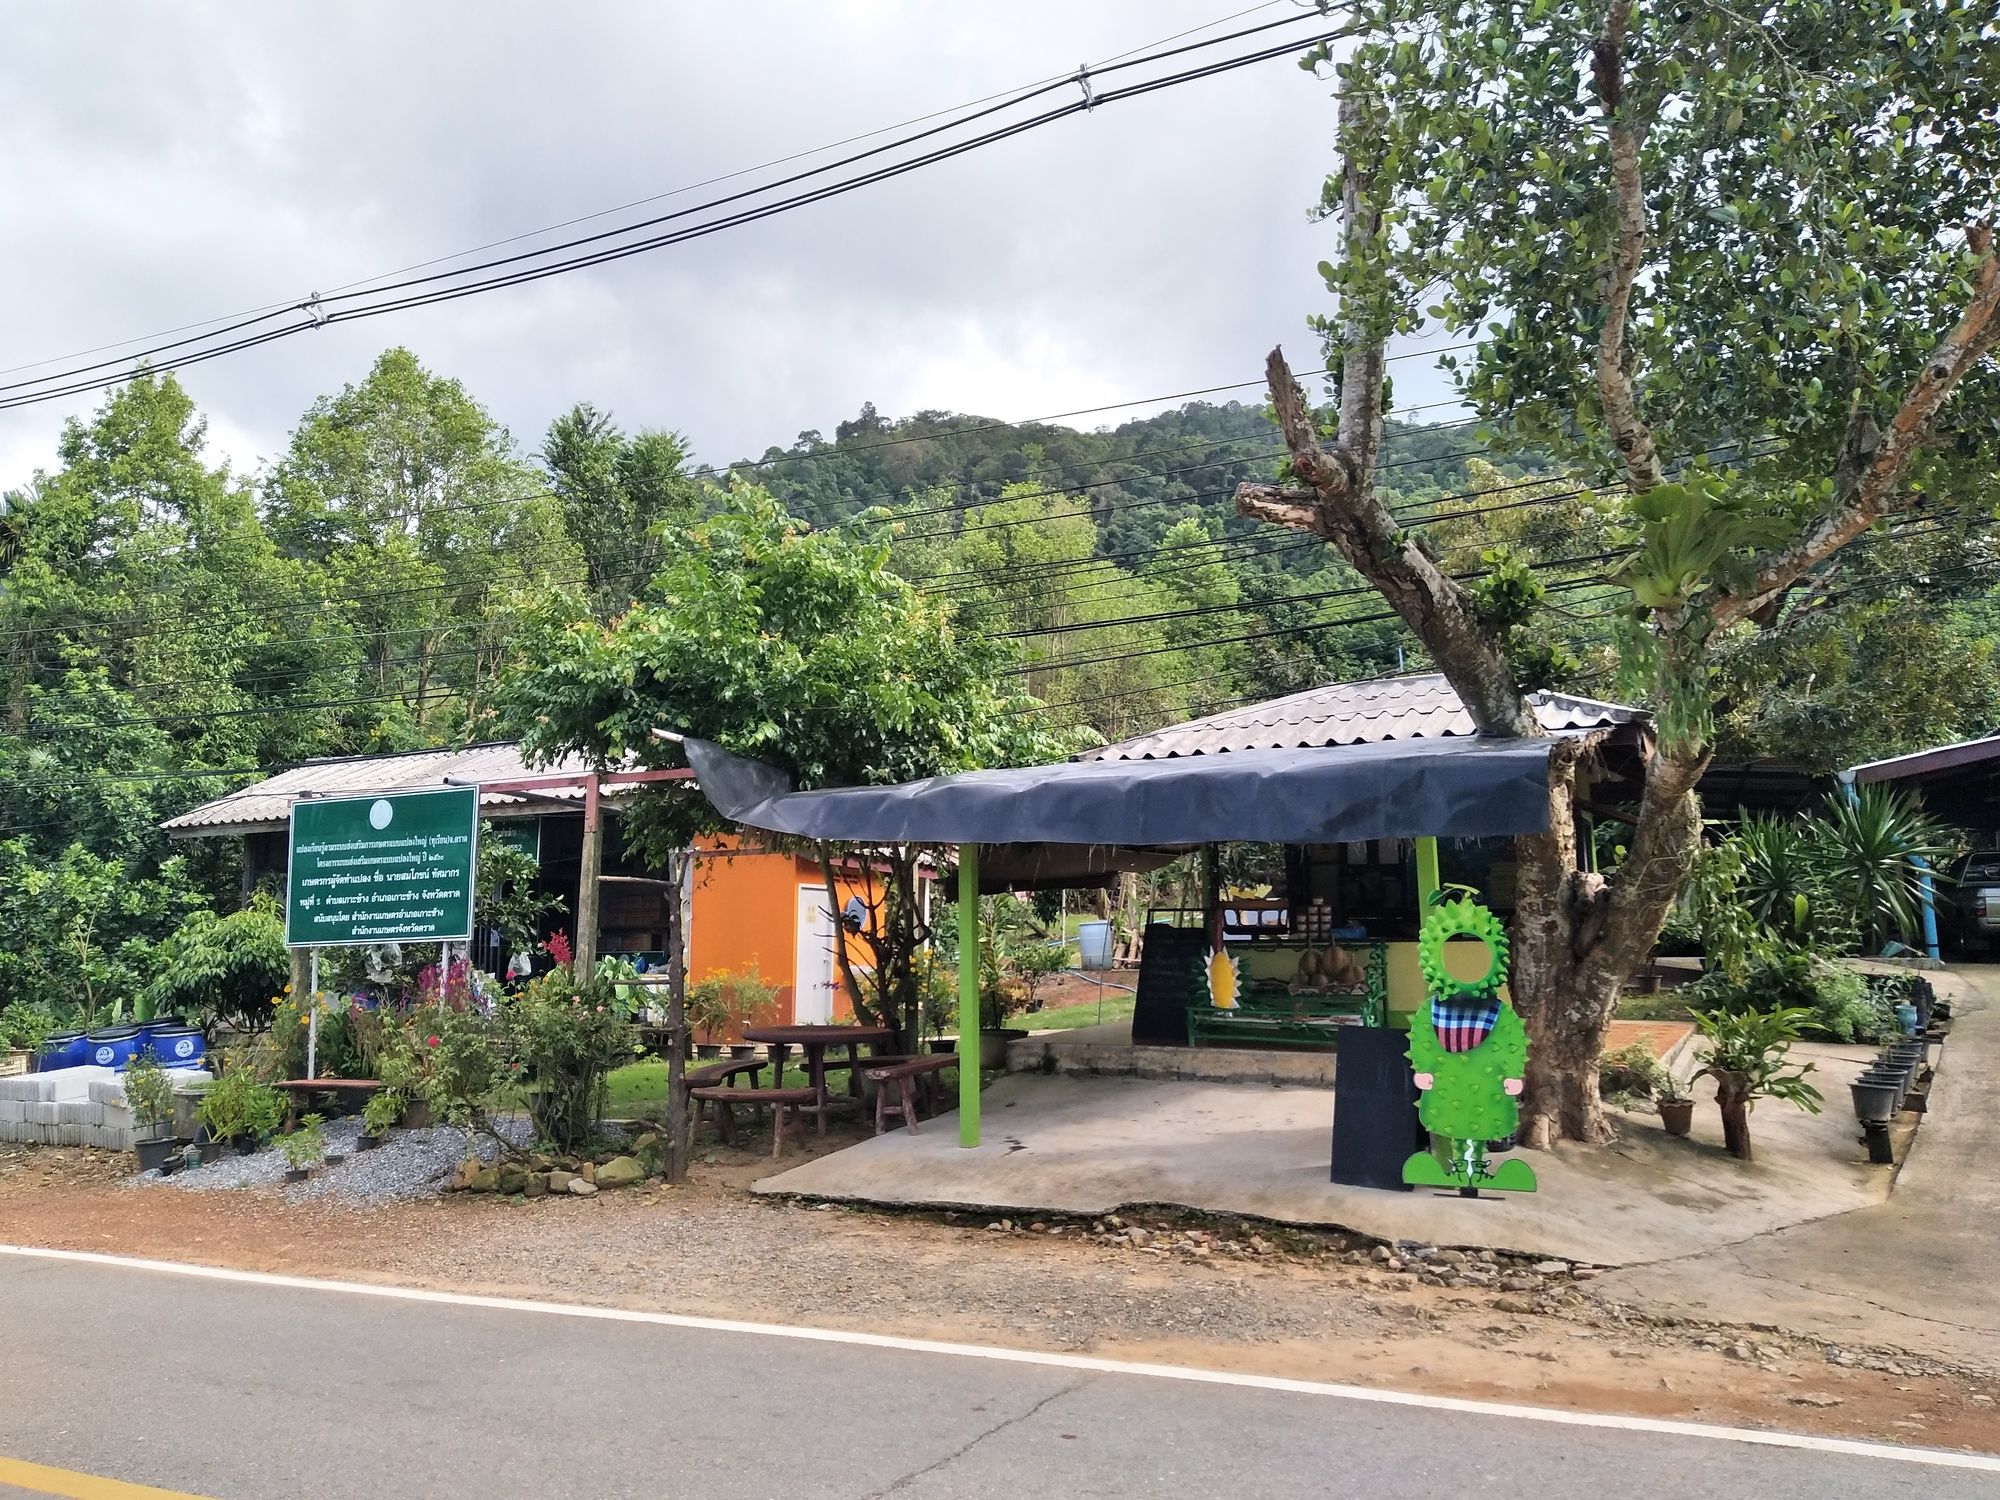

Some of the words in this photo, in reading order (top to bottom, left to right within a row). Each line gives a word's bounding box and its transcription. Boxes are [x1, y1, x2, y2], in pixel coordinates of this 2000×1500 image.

[422, 851, 427, 861] ปี
[428, 853, 444, 861] ๒๕๖๐
[302, 872, 371, 889] เกษตรกรผู้จัดทำแปลง
[373, 869, 384, 882] ชื่อ
[386, 868, 430, 882] นายสมโภชน์
[299, 893, 315, 910] หมู่ที่
[316, 897, 321, 906] 2
[325, 892, 370, 905] ตำบลเกาะช้าง
[371, 890, 419, 903] อำเภอเกาะช้าง
[421, 888, 461, 900] จังหวัดตราด
[313, 910, 350, 925] สนับสนุนโดย
[351, 907, 444, 921] สำนักงานเกษตรอำเภอเกาะช้าง
[351, 923, 436, 936] สำนักงานเกษตรจังหวัดตราด
